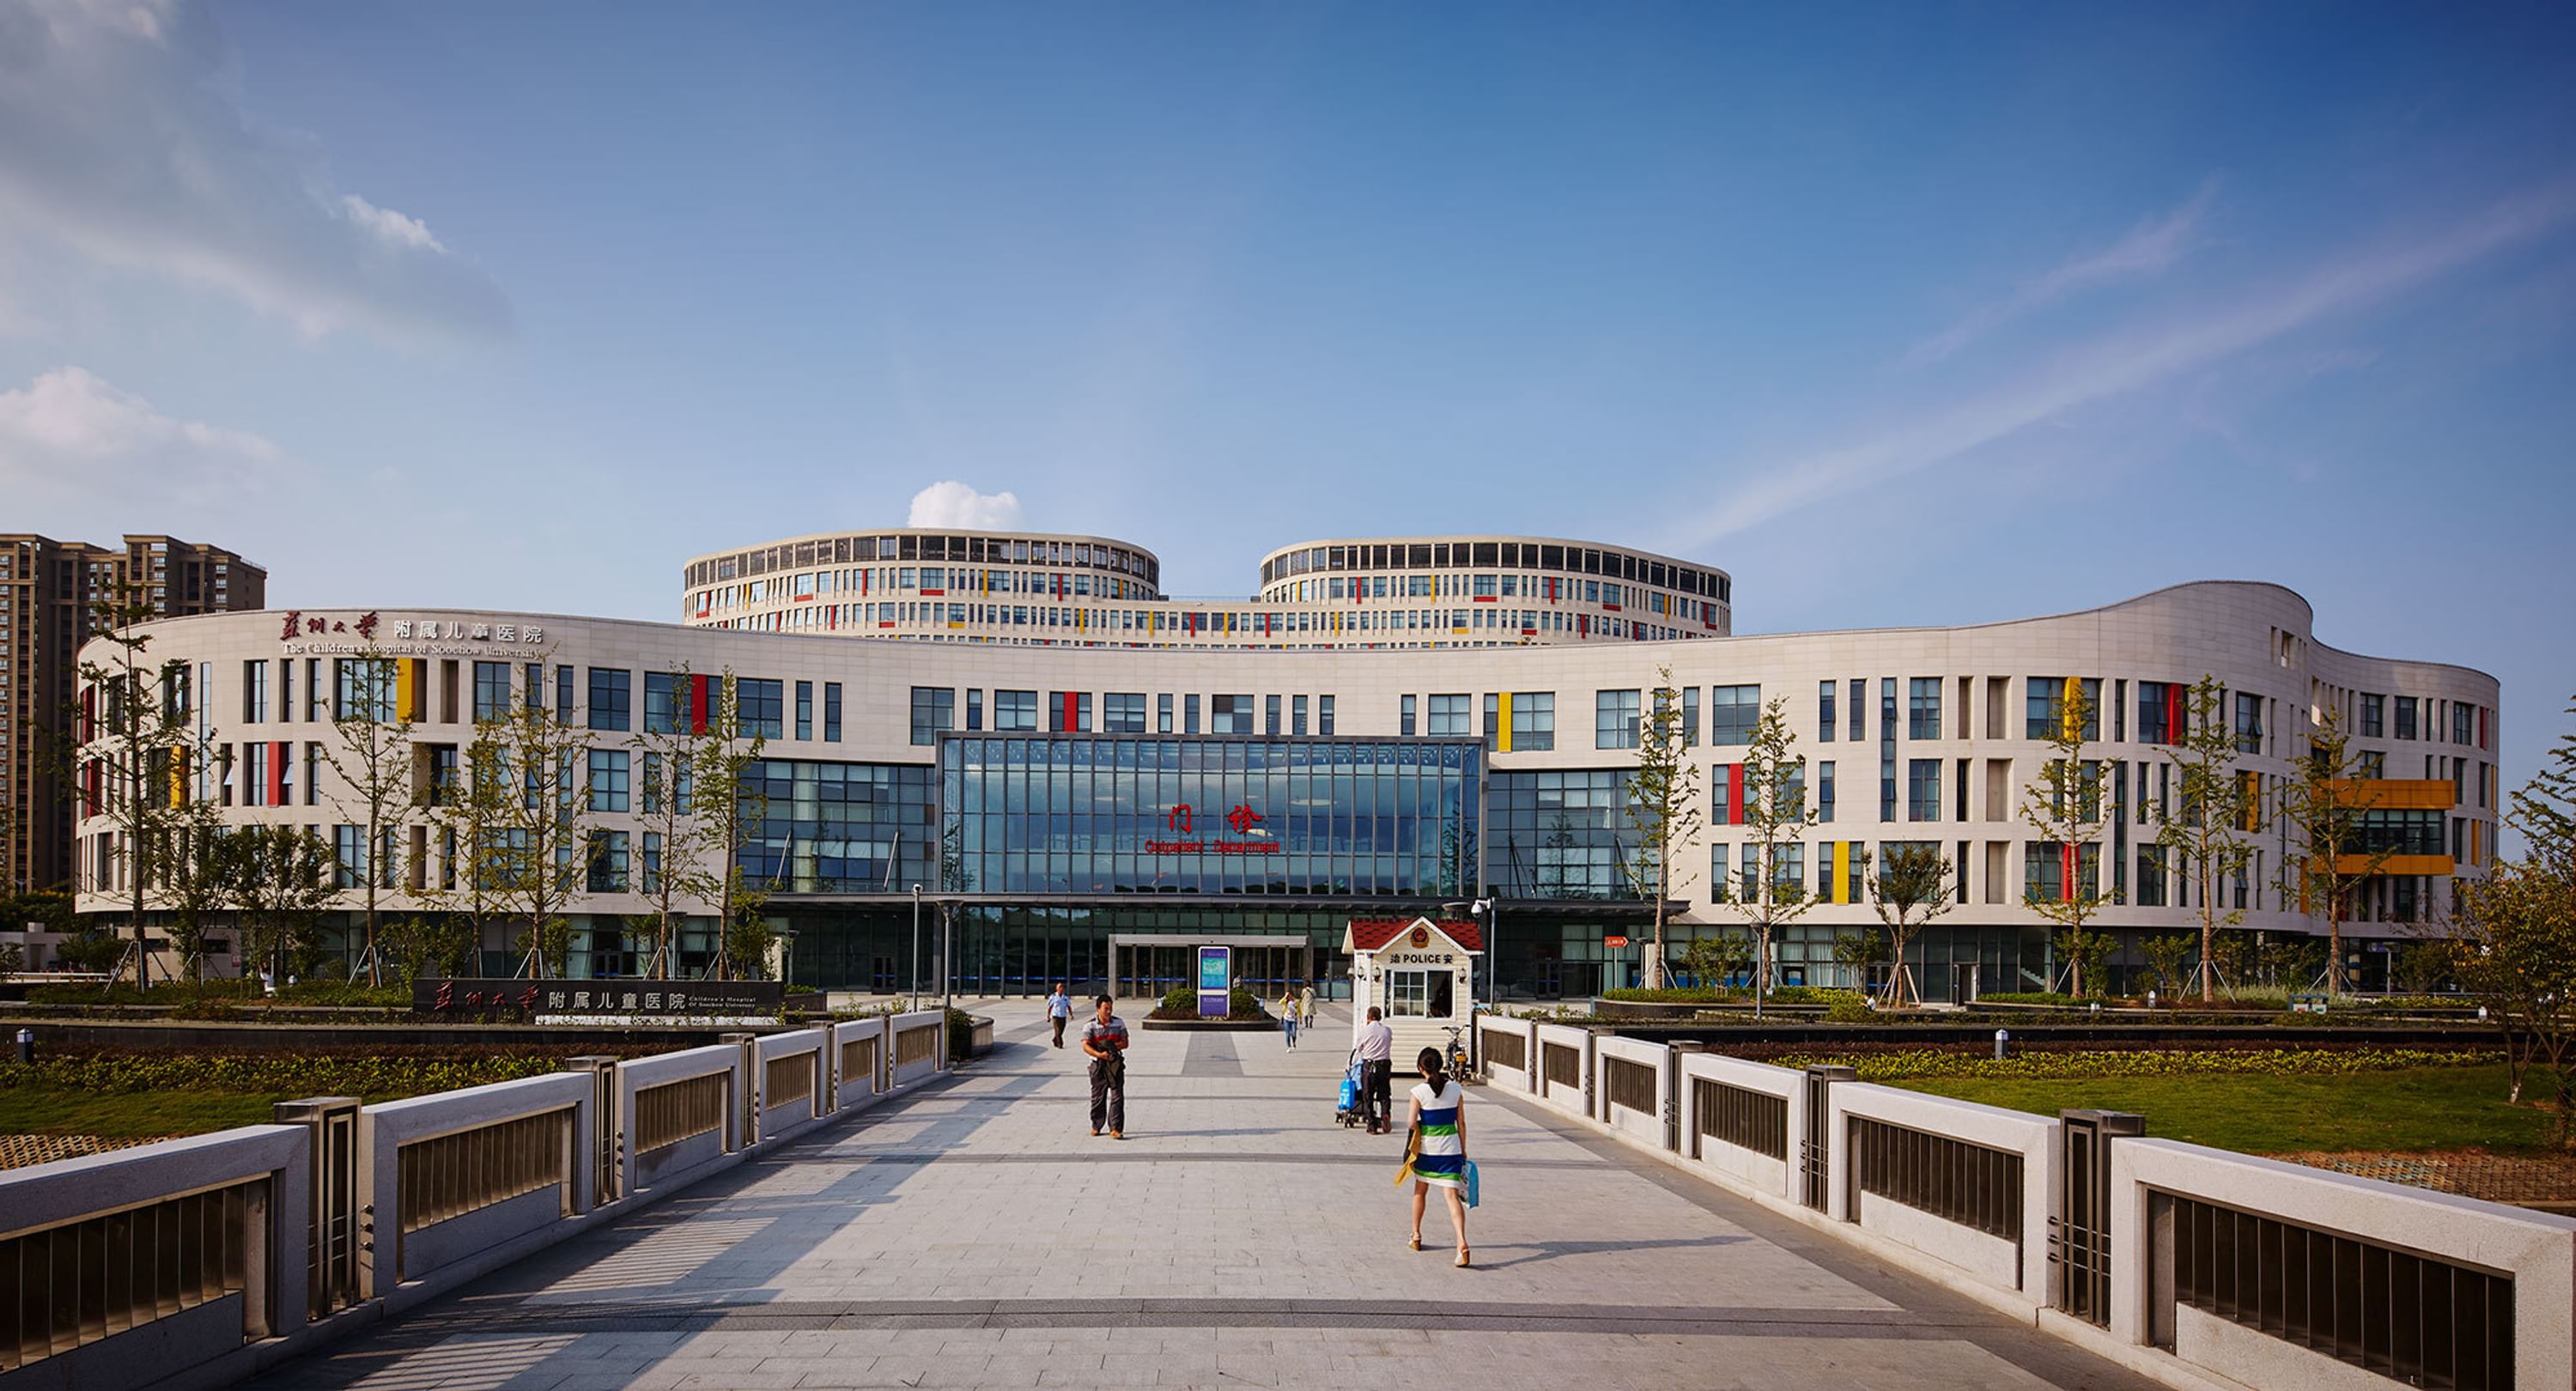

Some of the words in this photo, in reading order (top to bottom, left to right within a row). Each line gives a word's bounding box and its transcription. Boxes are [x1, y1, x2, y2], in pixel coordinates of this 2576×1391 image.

[393, 619, 544, 643] 附属儿童医院
[282, 642, 303, 653] The
[306, 642, 363, 653] Children's
[415, 643, 427, 654] of
[431, 644, 481, 656] Soochow
[484, 645, 540, 659] University
[1169, 804, 1263, 835] 门诊
[1145, 839, 1204, 855] Outpatient
[1213, 839, 1280, 855] Department
[1389, 954, 1400, 963] 治
[1403, 954, 1441, 963] POLICE
[1443, 954, 1453, 963] 安
[548, 991, 686, 1010] 附属儿童医院
